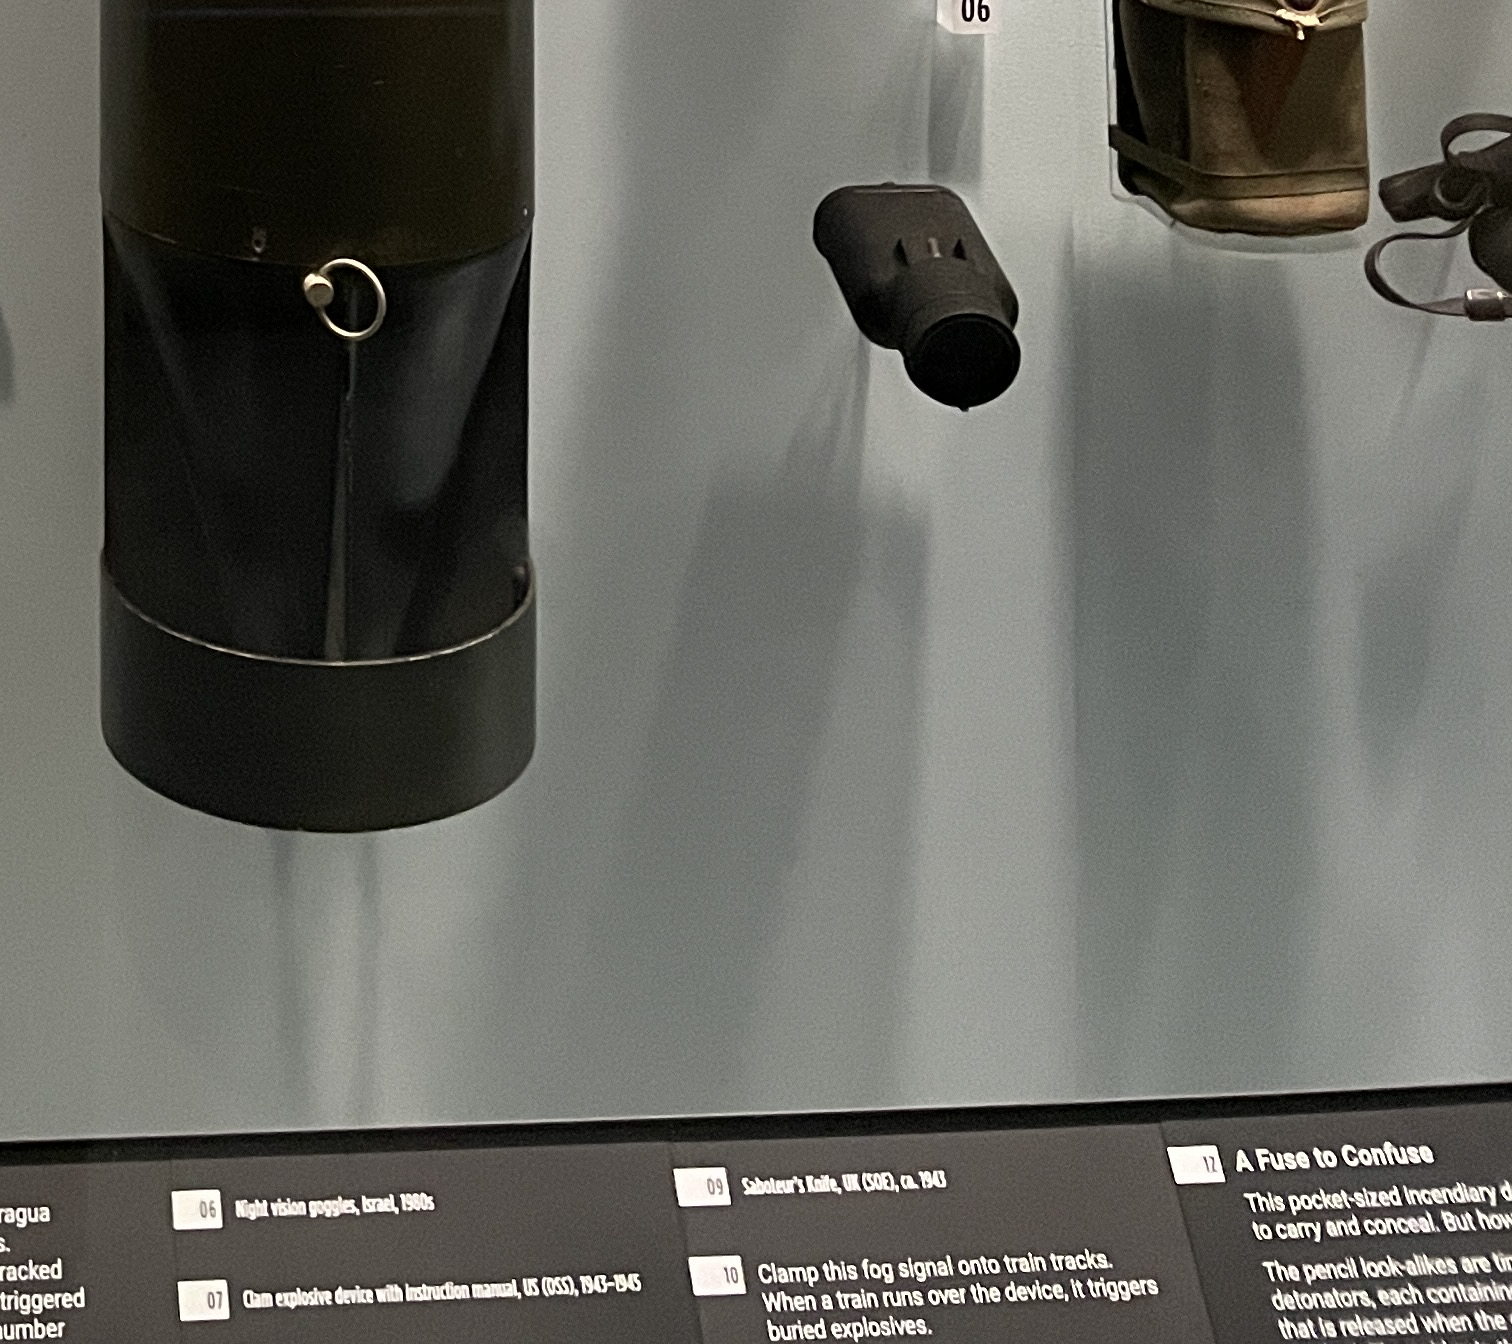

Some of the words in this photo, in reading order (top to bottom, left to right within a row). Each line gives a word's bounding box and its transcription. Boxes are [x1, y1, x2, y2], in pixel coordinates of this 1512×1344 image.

[1235, 1149, 1255, 1173] A
[1254, 1148, 1311, 1172] Fuse
[1312, 1146, 1338, 1169] to
[1341, 1141, 1435, 1167] Confuse
[706, 1177, 724, 1196] 09
[199, 1200, 217, 1218] 06
[723, 1267, 739, 1284] 10
[757, 1262, 820, 1287] Clamp
[821, 1259, 859, 1282] this
[861, 1258, 895, 1284] fog
[897, 1254, 954, 1283] signal
[957, 1255, 1001, 1276] onto
[1002, 1251, 1048, 1274] train
[1049, 1248, 1114, 1272] tracks.
[0, 1286, 86, 1315] triggered
[207, 1291, 224, 1310] 07
[761, 1290, 817, 1313] When
[820, 1294, 834, 1311] a
[835, 1288, 880, 1310] train
[882, 1290, 925, 1308] runs
[927, 1287, 967, 1306] over
[969, 1282, 1001, 1304] the
[1004, 1279, 1070, 1302] device,
[1069, 1278, 1086, 1299] it
[1086, 1276, 1159, 1302] triggers
[766, 1317, 828, 1342] buried
[830, 1315, 933, 1343] explosives.
